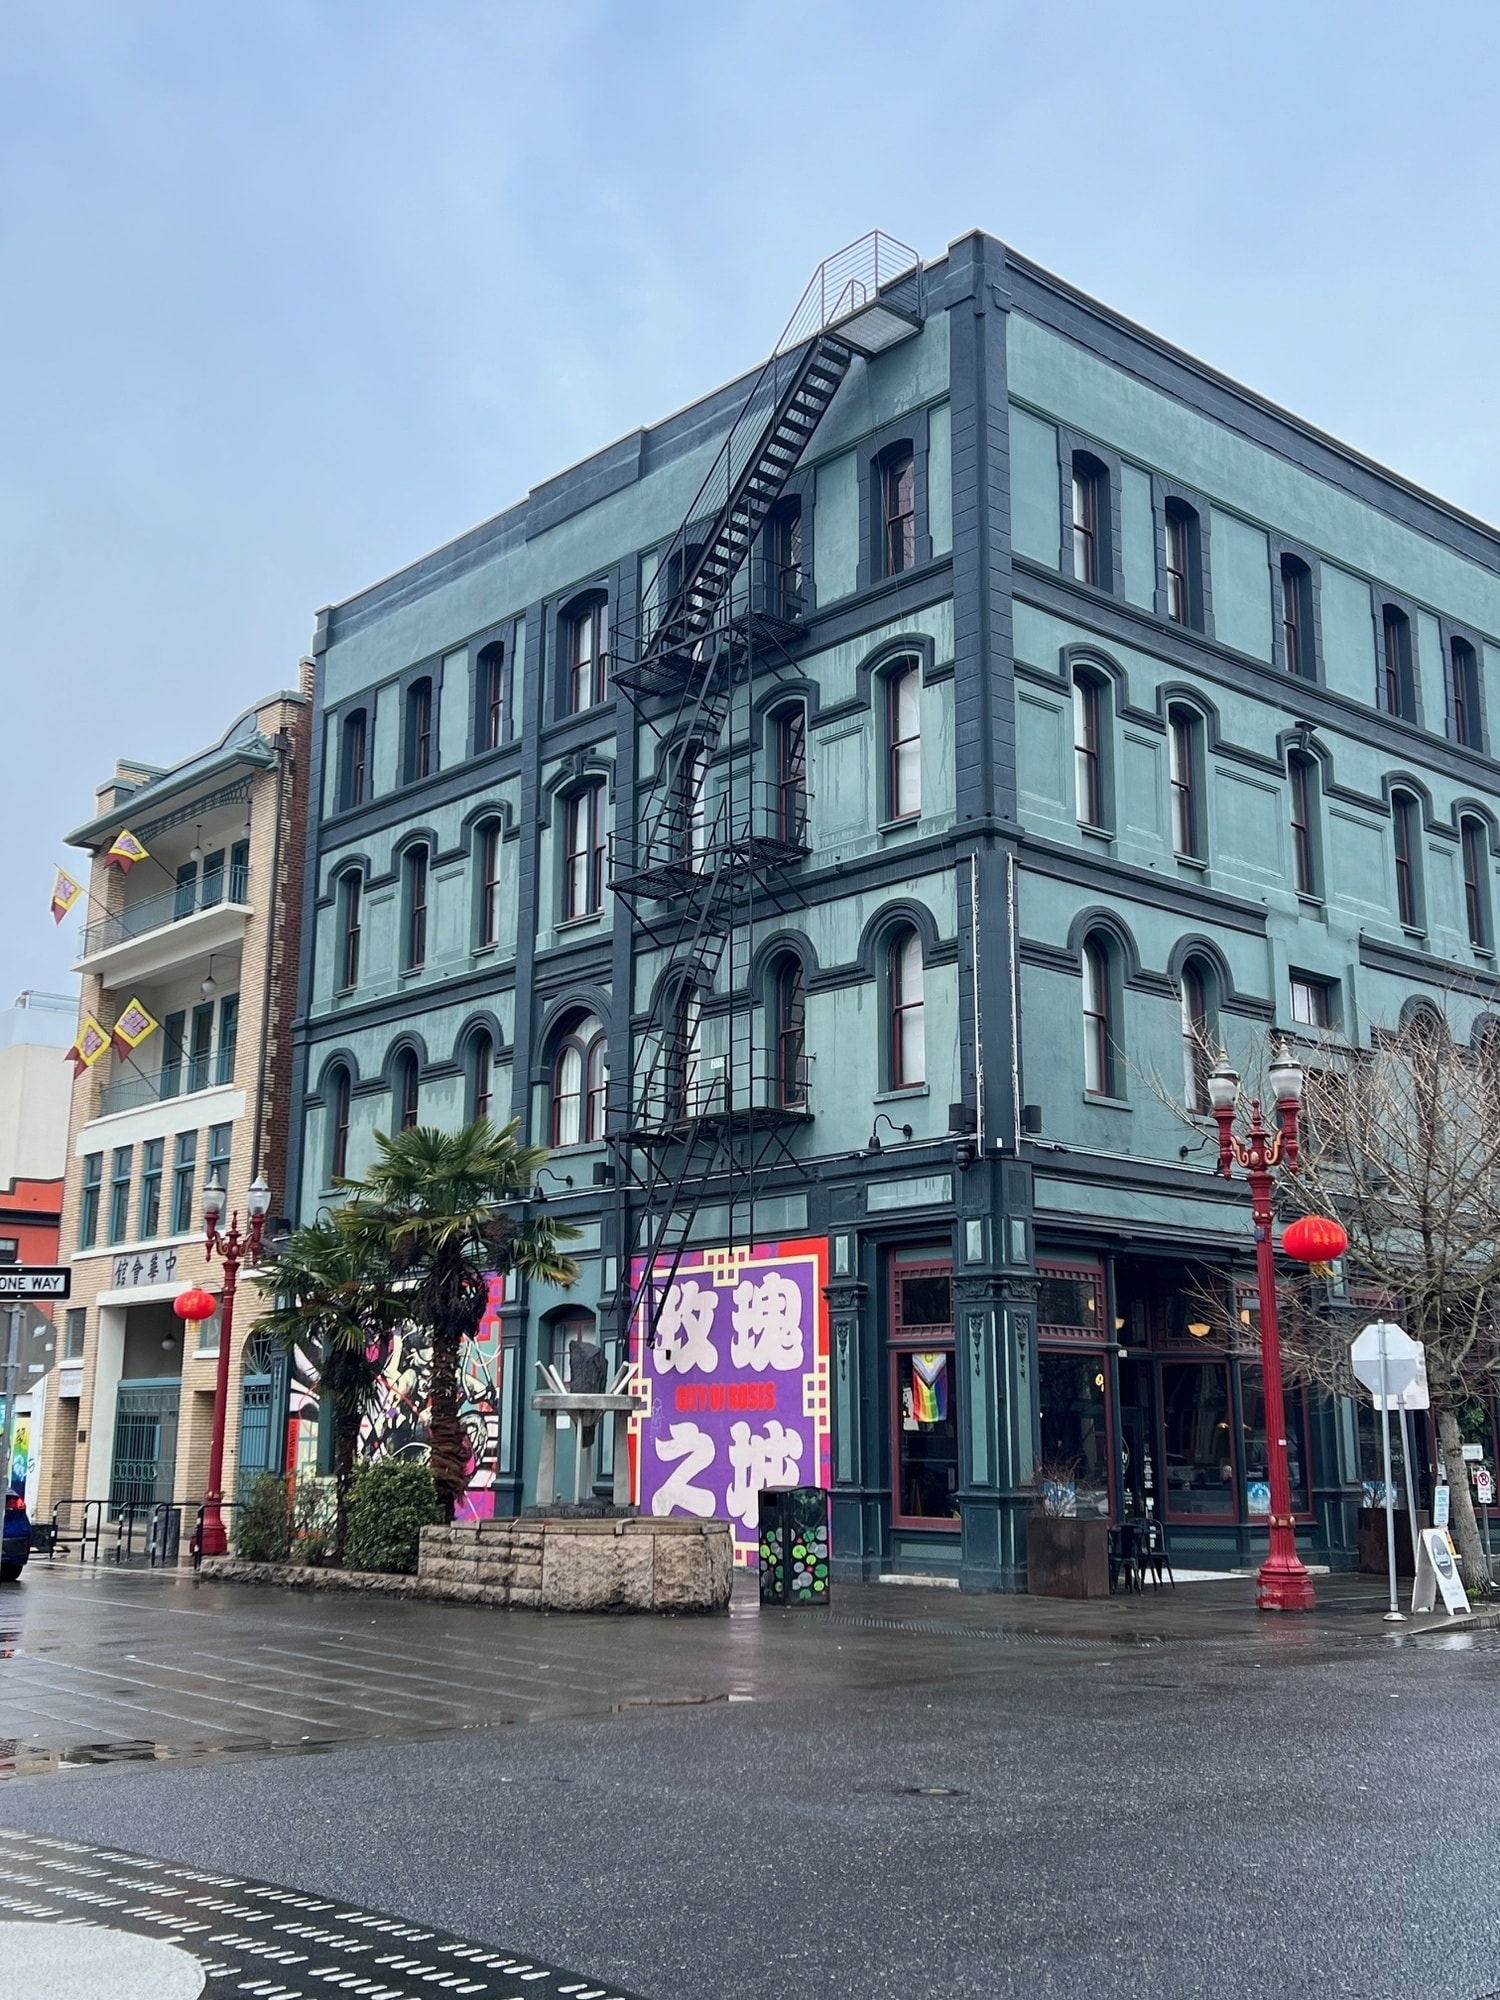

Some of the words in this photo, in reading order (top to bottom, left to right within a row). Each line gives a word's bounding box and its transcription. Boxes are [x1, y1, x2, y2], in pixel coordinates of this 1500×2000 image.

[0, 1277, 26, 1290] ONE
[32, 1277, 61, 1290] WAY
[653, 1271, 804, 1375] 玫瑰
[676, 1384, 708, 1412] CITY
[728, 1381, 776, 1411] ROSES
